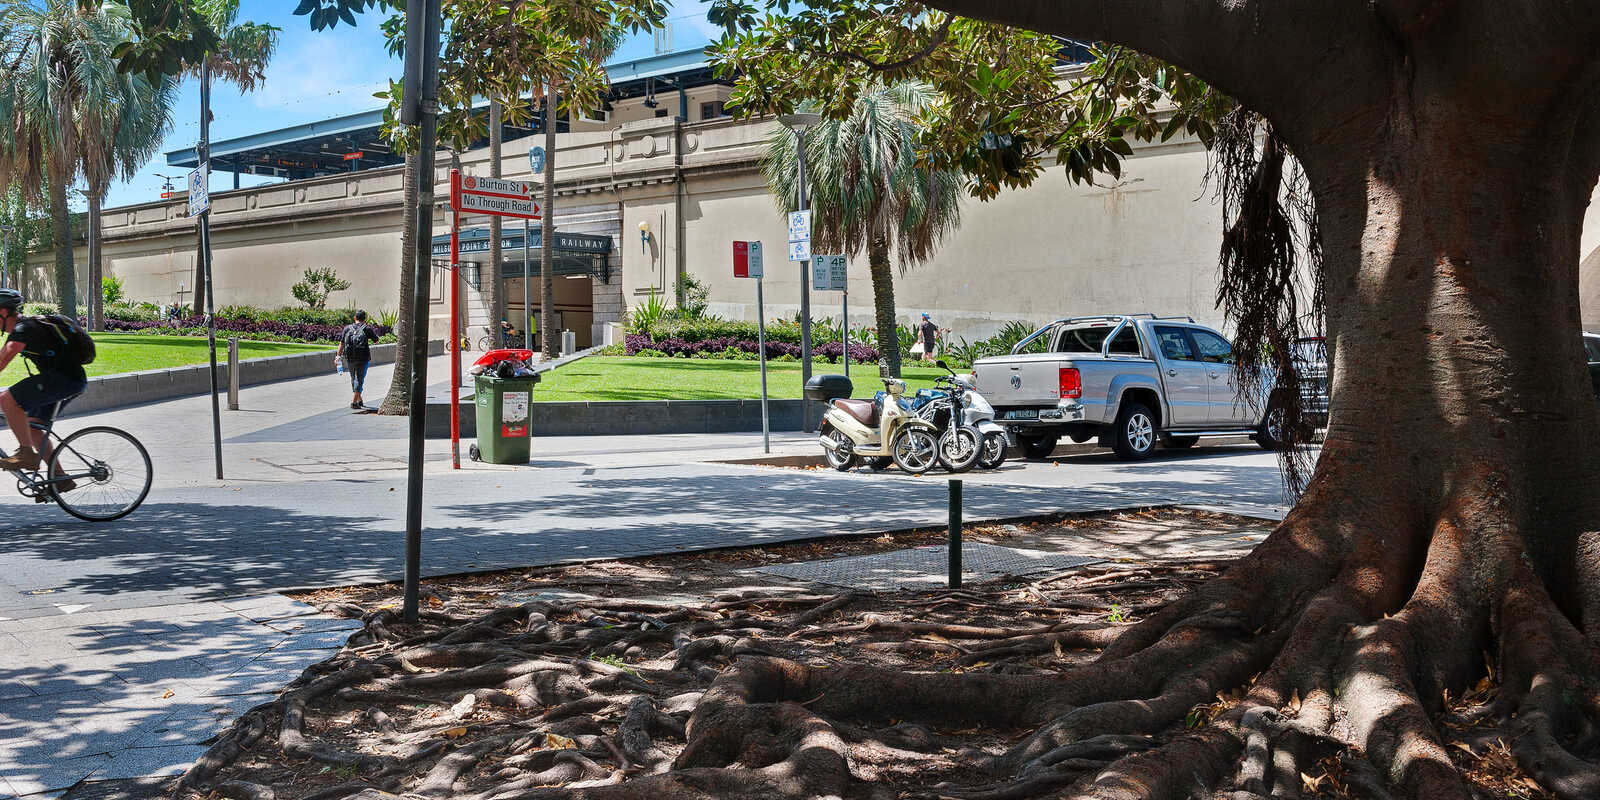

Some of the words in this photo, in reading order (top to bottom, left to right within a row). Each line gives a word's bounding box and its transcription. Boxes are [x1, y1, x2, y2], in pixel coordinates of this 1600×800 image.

[479, 178, 507, 191] Burton
[510, 181, 520, 192] St
[463, 195, 475, 206] No
[478, 197, 510, 211] Through
[512, 200, 531, 211] Road
[461, 242, 481, 251] POINT
[561, 238, 603, 249] RAILWAY
[752, 243, 758, 252] P
[817, 256, 824, 266] P
[831, 257, 846, 266] 4P
